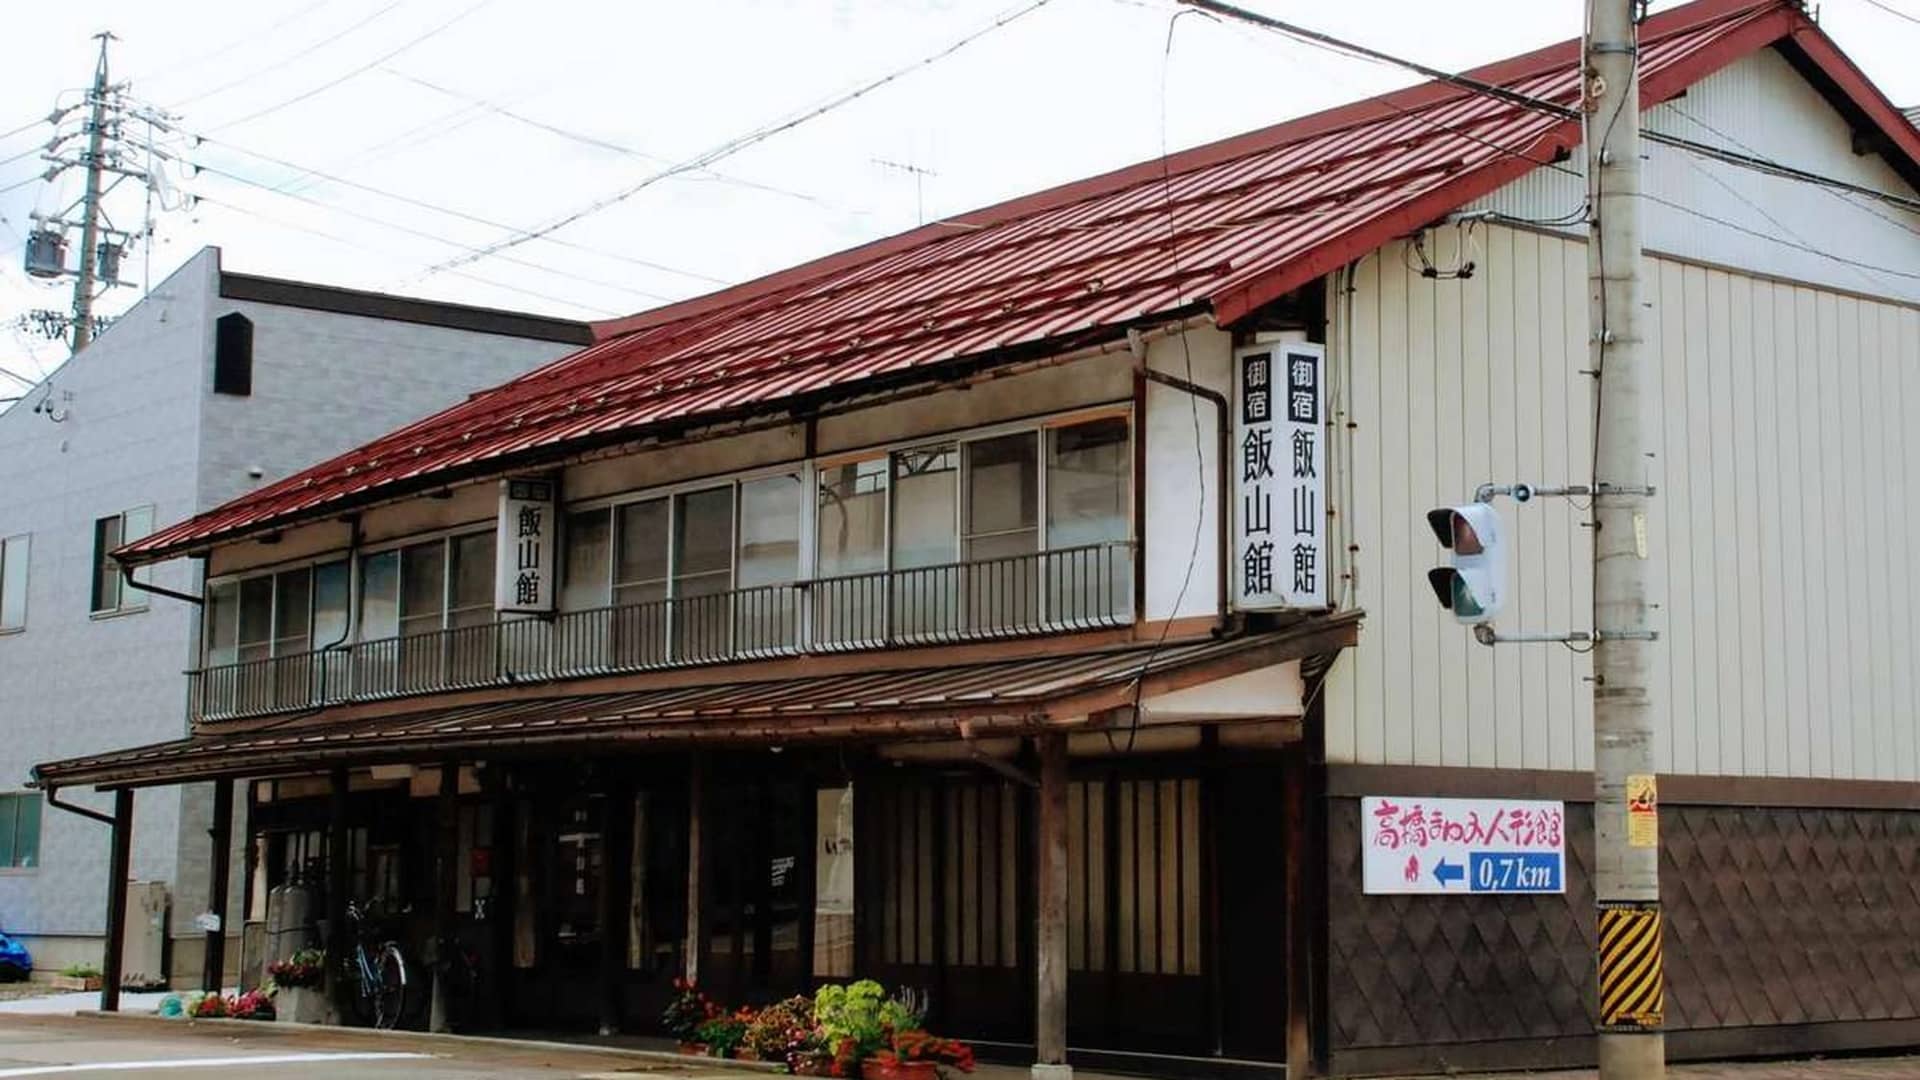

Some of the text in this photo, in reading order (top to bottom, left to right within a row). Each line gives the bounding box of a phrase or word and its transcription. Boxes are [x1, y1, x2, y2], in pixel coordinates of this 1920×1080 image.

[516, 505, 541, 605] 飯山館
[1242, 428, 1273, 597] 飯山館
[1291, 359, 1316, 594] 御宿 飯山館
